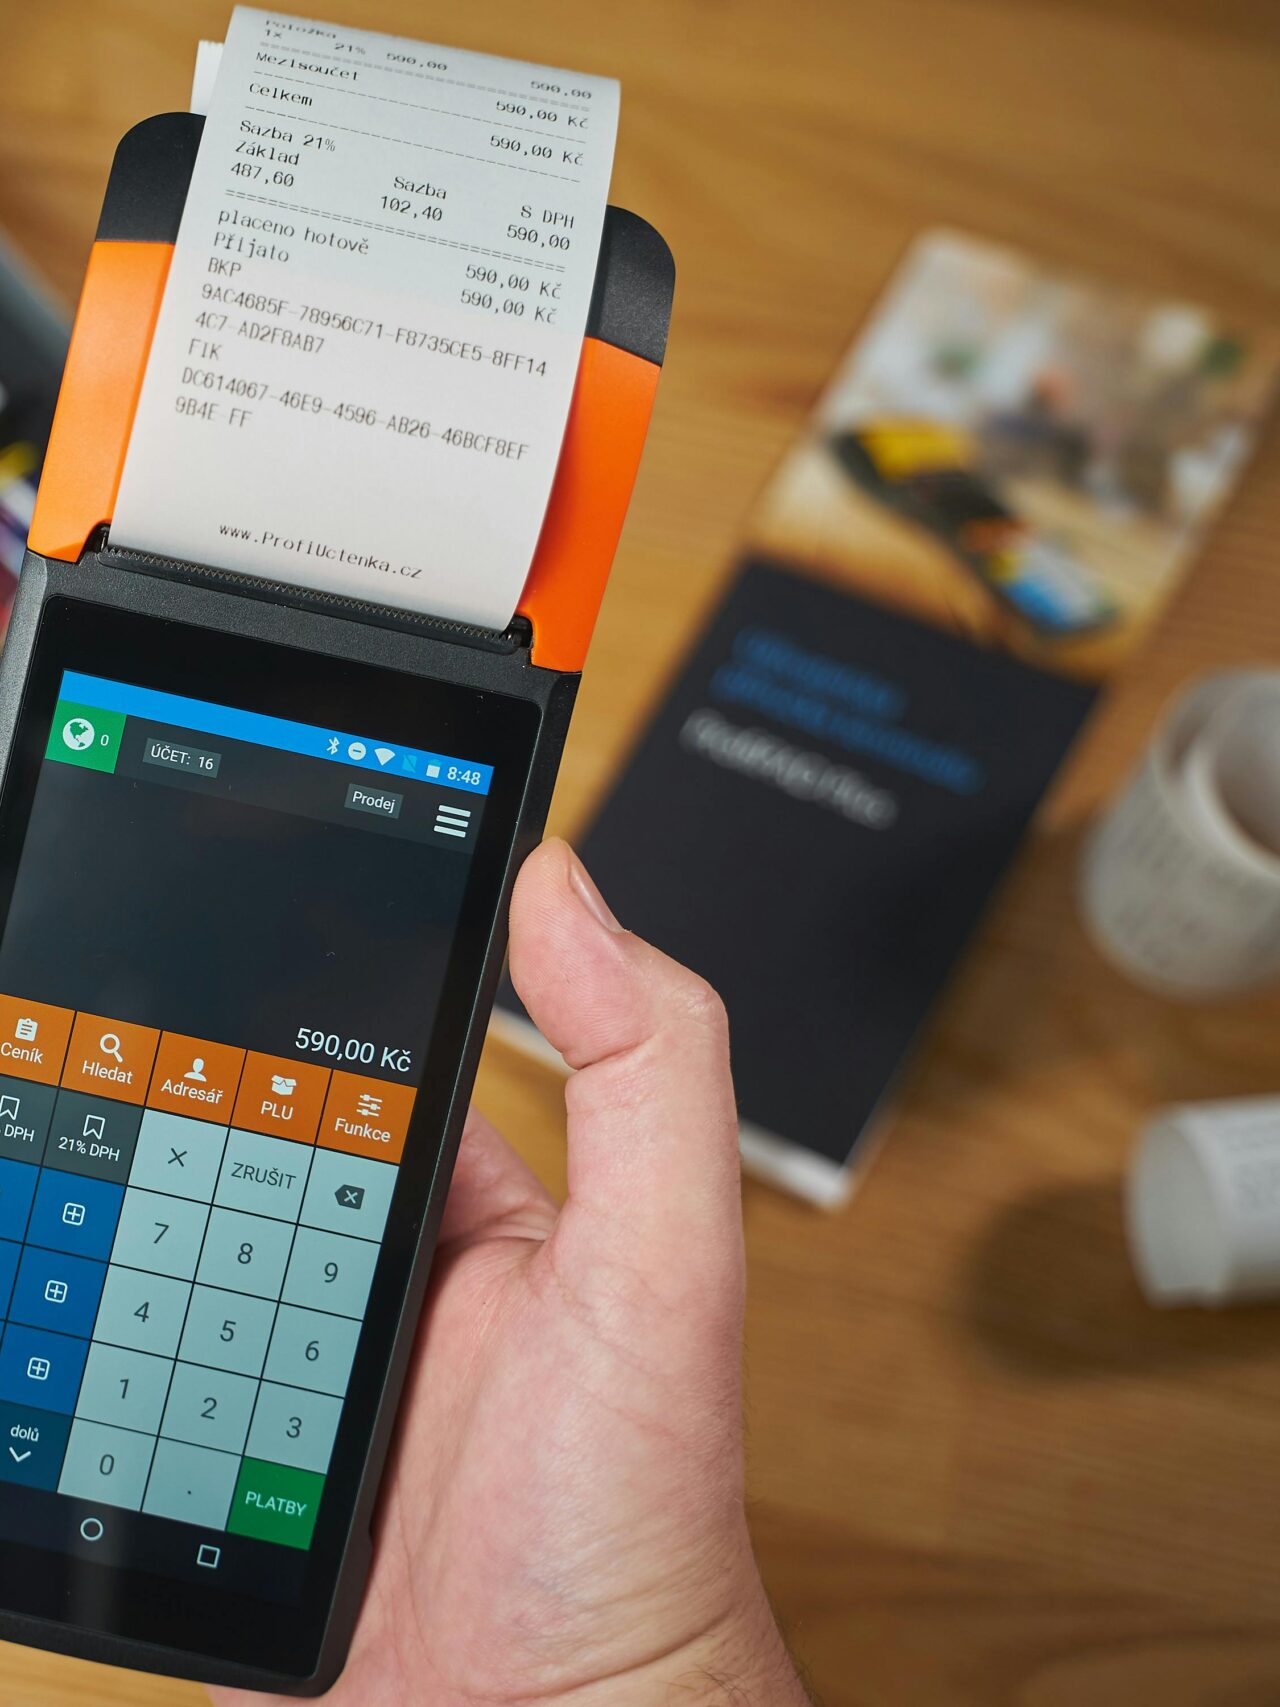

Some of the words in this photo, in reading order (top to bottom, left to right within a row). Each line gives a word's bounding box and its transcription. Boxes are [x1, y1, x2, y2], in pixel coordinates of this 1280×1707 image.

[334, 42, 366, 56] 21%
[255, 51, 359, 81] Mezisoučet
[496, 101, 558, 123] 590,00
[568, 114, 590, 130] Kč
[249, 82, 313, 107] Celkem
[490, 135, 552, 160] 590,00
[562, 150, 584, 167] Kč
[240, 120, 293, 144] Sazba
[303, 134, 336, 153] 21%
[235, 140, 300, 167] Základ
[393, 176, 448, 201] Sazba
[521, 204, 532, 219] S
[542, 208, 575, 230] DPH
[230, 162, 295, 188] 487,60
[381, 196, 444, 222] 102,40
[507, 224, 570, 251] 590,00
[218, 209, 295, 239] placeno
[305, 226, 369, 255] hotově
[465, 264, 530, 292] 590,00
[540, 279, 562, 299] Kč
[207, 256, 242, 278] BKP
[213, 230, 290, 263] Přijato
[460, 289, 525, 317] 590,00
[535, 305, 557, 325] Kč
[188, 338, 222, 361] FIK
[219, 524, 423, 580] www.ProfiUctenka.cz
[99, 733, 110, 747] 0
[150, 742, 192, 767] ÚČET:
[198, 755, 214, 771] 16
[447, 766, 481, 786] 8:48
[352, 791, 396, 814] Prodej
[0, 1042, 43, 1064] Ceník
[295, 1027, 375, 1065] 590,00
[380, 1045, 412, 1073] Kč
[82, 1060, 133, 1086] Hledat
[161, 1078, 224, 1105] Adresář
[260, 1101, 294, 1121] PLU
[4, 1124, 35, 1143] DPH
[334, 1118, 391, 1143] Funkce
[58, 1136, 86, 1156] 21%
[89, 1143, 120, 1162] DPH
[231, 1161, 297, 1190] ZRUŠIT
[152, 1222, 169, 1244] 7
[237, 1242, 254, 1265] 8
[323, 1261, 339, 1283] 9
[133, 1301, 150, 1324] 4
[219, 1320, 236, 1342] 5
[305, 1340, 320, 1362] 6
[120, 1378, 130, 1400] 1
[200, 1397, 218, 1420] 2
[10, 1424, 40, 1443] dolů
[285, 1416, 303, 1439] 3
[98, 1453, 115, 1476] 0
[245, 1490, 308, 1518] PLATBY
